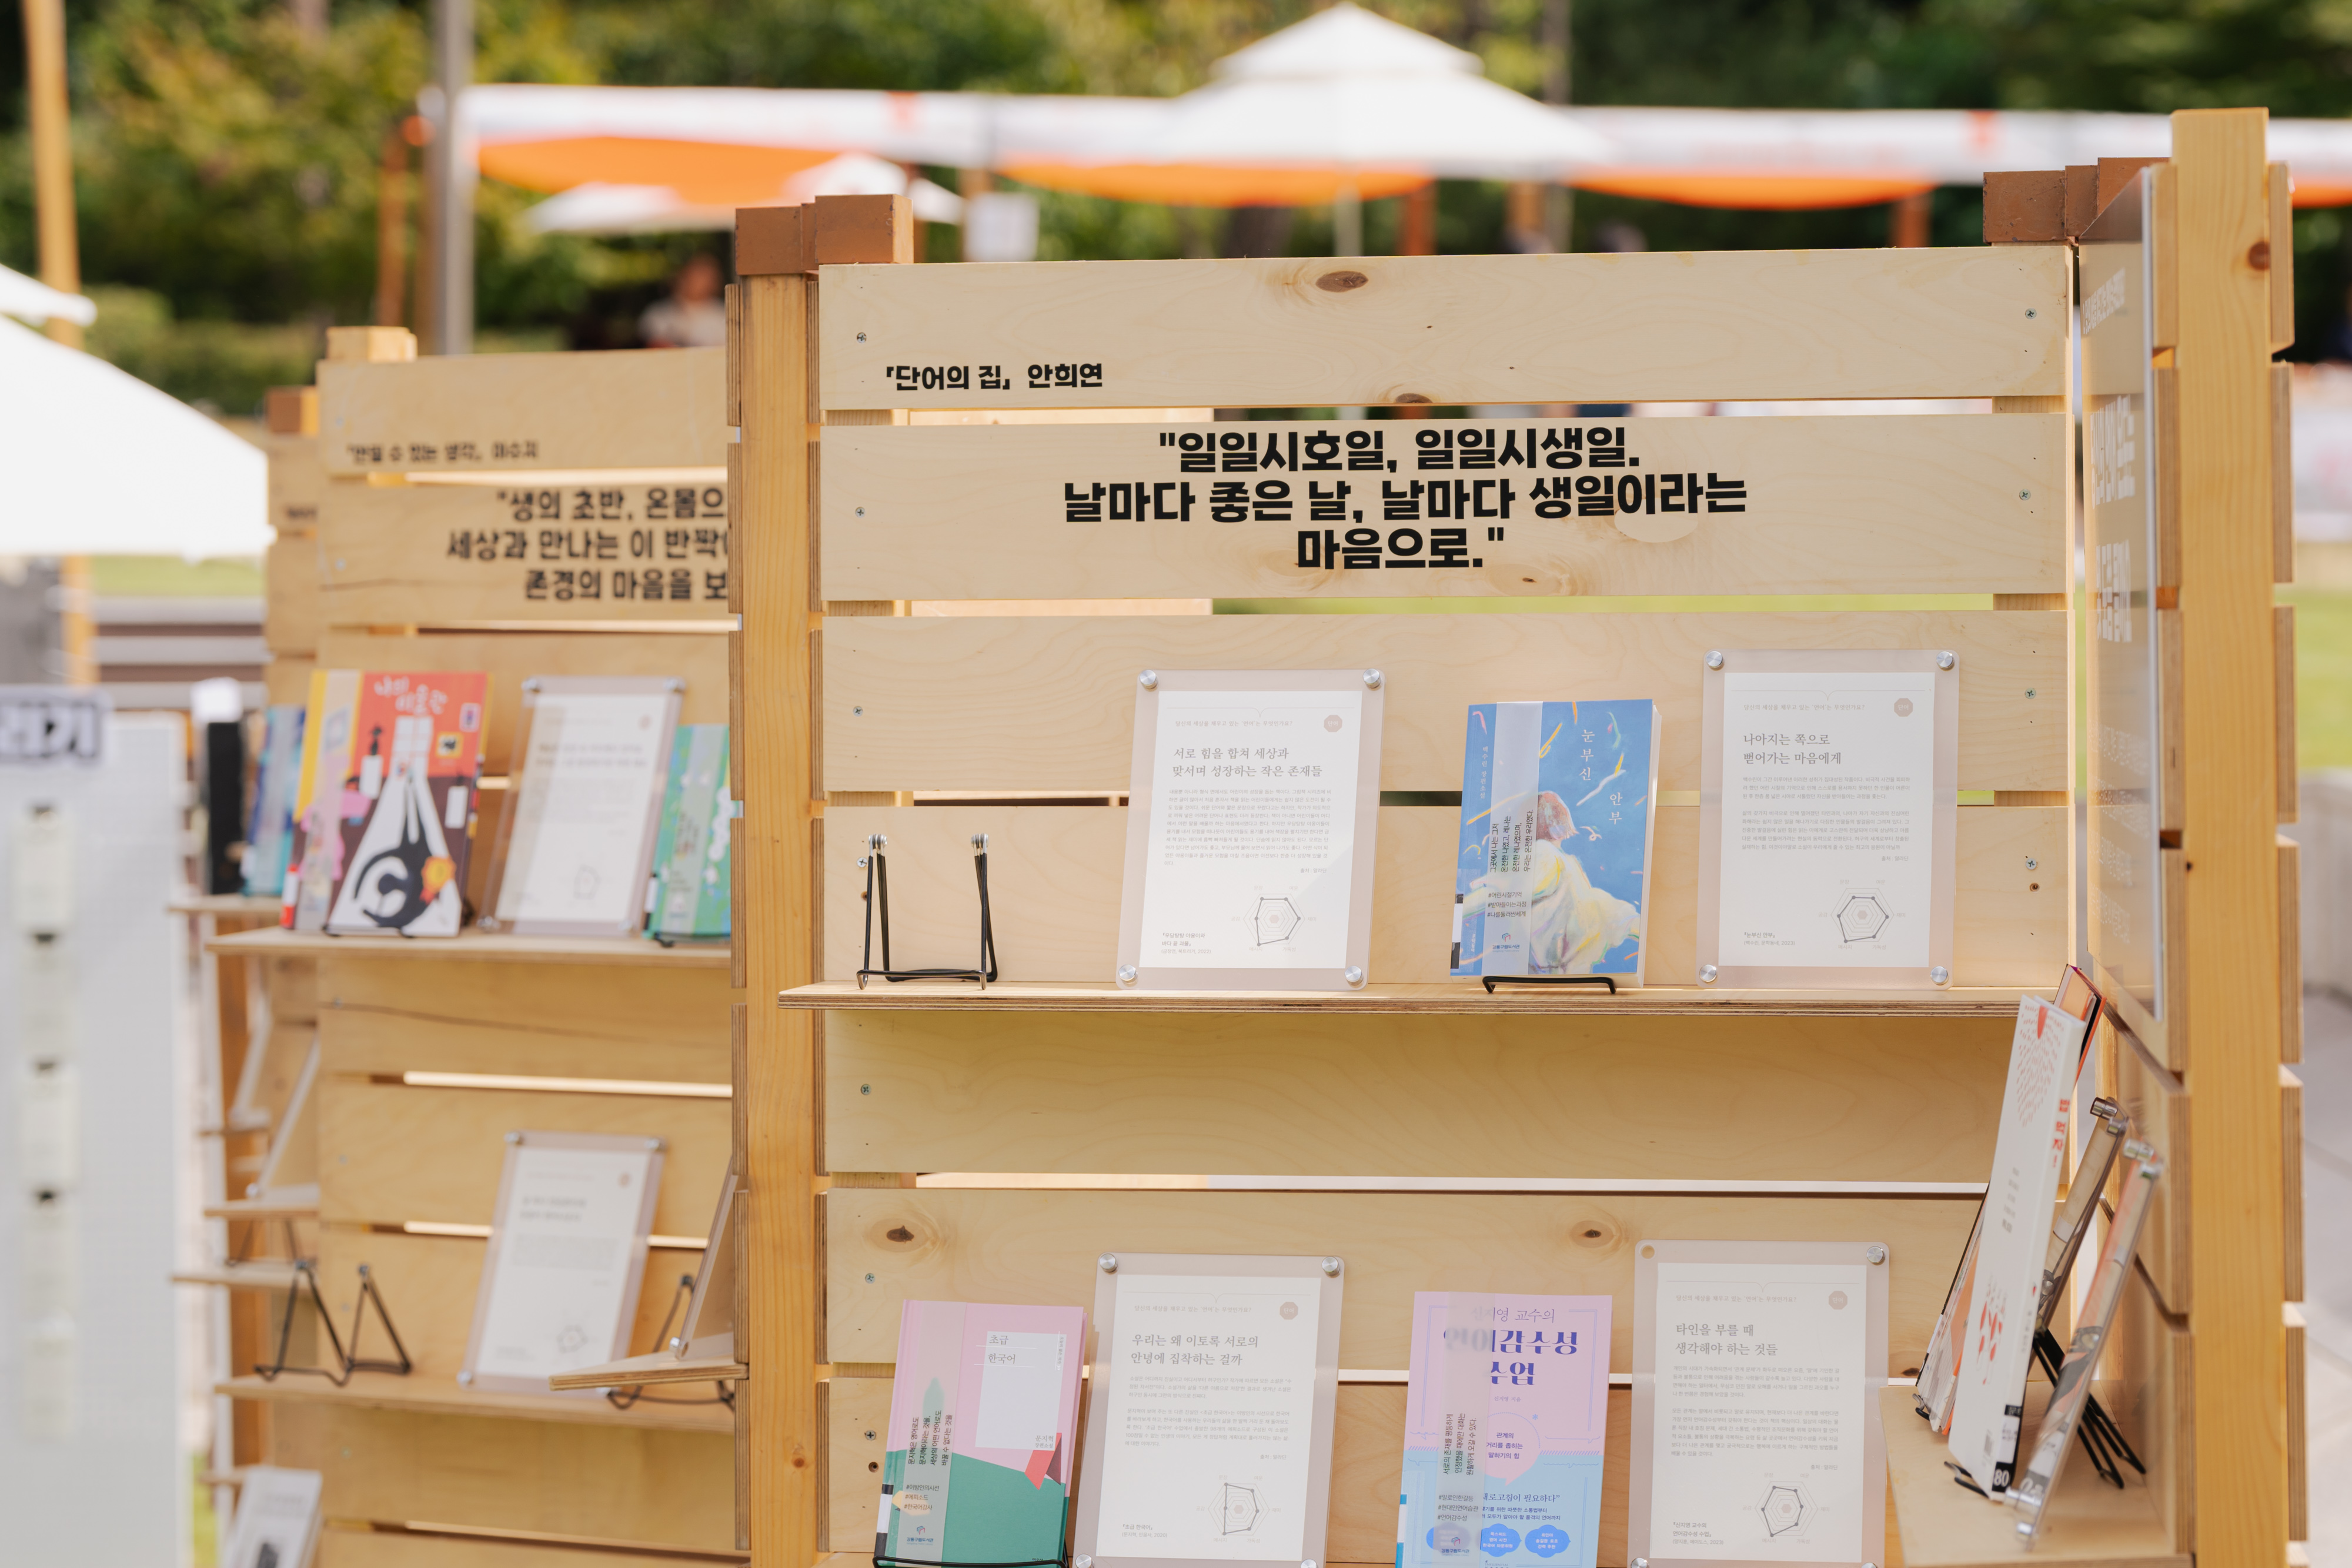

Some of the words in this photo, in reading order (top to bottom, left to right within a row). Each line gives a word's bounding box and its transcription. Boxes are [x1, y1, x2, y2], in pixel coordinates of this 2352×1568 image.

[1027, 363, 1102, 388] 안희연
[1415, 427, 1639, 470] 일일시생일.
[1064, 482, 1195, 522] 날마다
[1209, 480, 1292, 523] 좋은
[1308, 480, 1362, 523] 날,
[1382, 471, 1515, 520] 날마다
[1529, 468, 1746, 519] 생일이라는
[664, 529, 727, 559] 반짝
[1743, 733, 1790, 745] 나아지는
[1794, 734, 1830, 745] 쪽으로
[1174, 747, 1196, 759] 서로
[1201, 747, 1223, 759] 힘을
[1227, 747, 1249, 759] 합쳐
[1254, 747, 1289, 759] 세상과
[1579, 728, 1595, 781] 눈부신
[1743, 752, 1790, 764] 뻗어가는
[1794, 752, 1840, 764] 마음에게
[1172, 765, 1205, 777] 맞서며
[1211, 765, 1257, 777] 성장하는
[1260, 765, 1284, 777] 작은
[1287, 765, 1322, 777] 존재들
[1608, 792, 1623, 825] 안부
[1492, 823, 1499, 835] 그저
[1525, 809, 1534, 834] 우리였다.
[1491, 836, 1498, 848] 나는
[1513, 823, 1521, 853] 레나였으며,
[1523, 854, 1531, 871] 우리는
[1514, 1309, 1555, 1324] 교수의
[1676, 1323, 1710, 1336] 타인을
[1715, 1323, 1738, 1336] 부를
[1743, 1324, 1753, 1336] 때
[988, 1335, 1008, 1345] 초급
[1132, 1334, 1166, 1346] 우리는
[1170, 1335, 1181, 1346] 왜
[1186, 1335, 1220, 1347] 이토록
[1224, 1335, 1258, 1348] 서로의
[1675, 1342, 1722, 1355] 생각해야
[1726, 1342, 1750, 1355] 하는
[1755, 1343, 1778, 1355] 것들
[988, 1353, 1015, 1364] 한국어
[1131, 1352, 1164, 1364] 안녕에
[1169, 1352, 1215, 1365] 집착하는
[1220, 1353, 1242, 1365] 걸까
[1486, 1361, 1535, 1386] 수업
[933, 1410, 941, 1433] 언어로도
[945, 1415, 952, 1426] 것을
[910, 1417, 918, 1440] 영어로도
[943, 1427, 951, 1445] 없다는
[918, 1430, 928, 1465] 문지혁이라는
[931, 1435, 939, 1446] 어떤
[908, 1442, 917, 1464] 문지혁은
[941, 1454, 948, 1466] 바꿀
